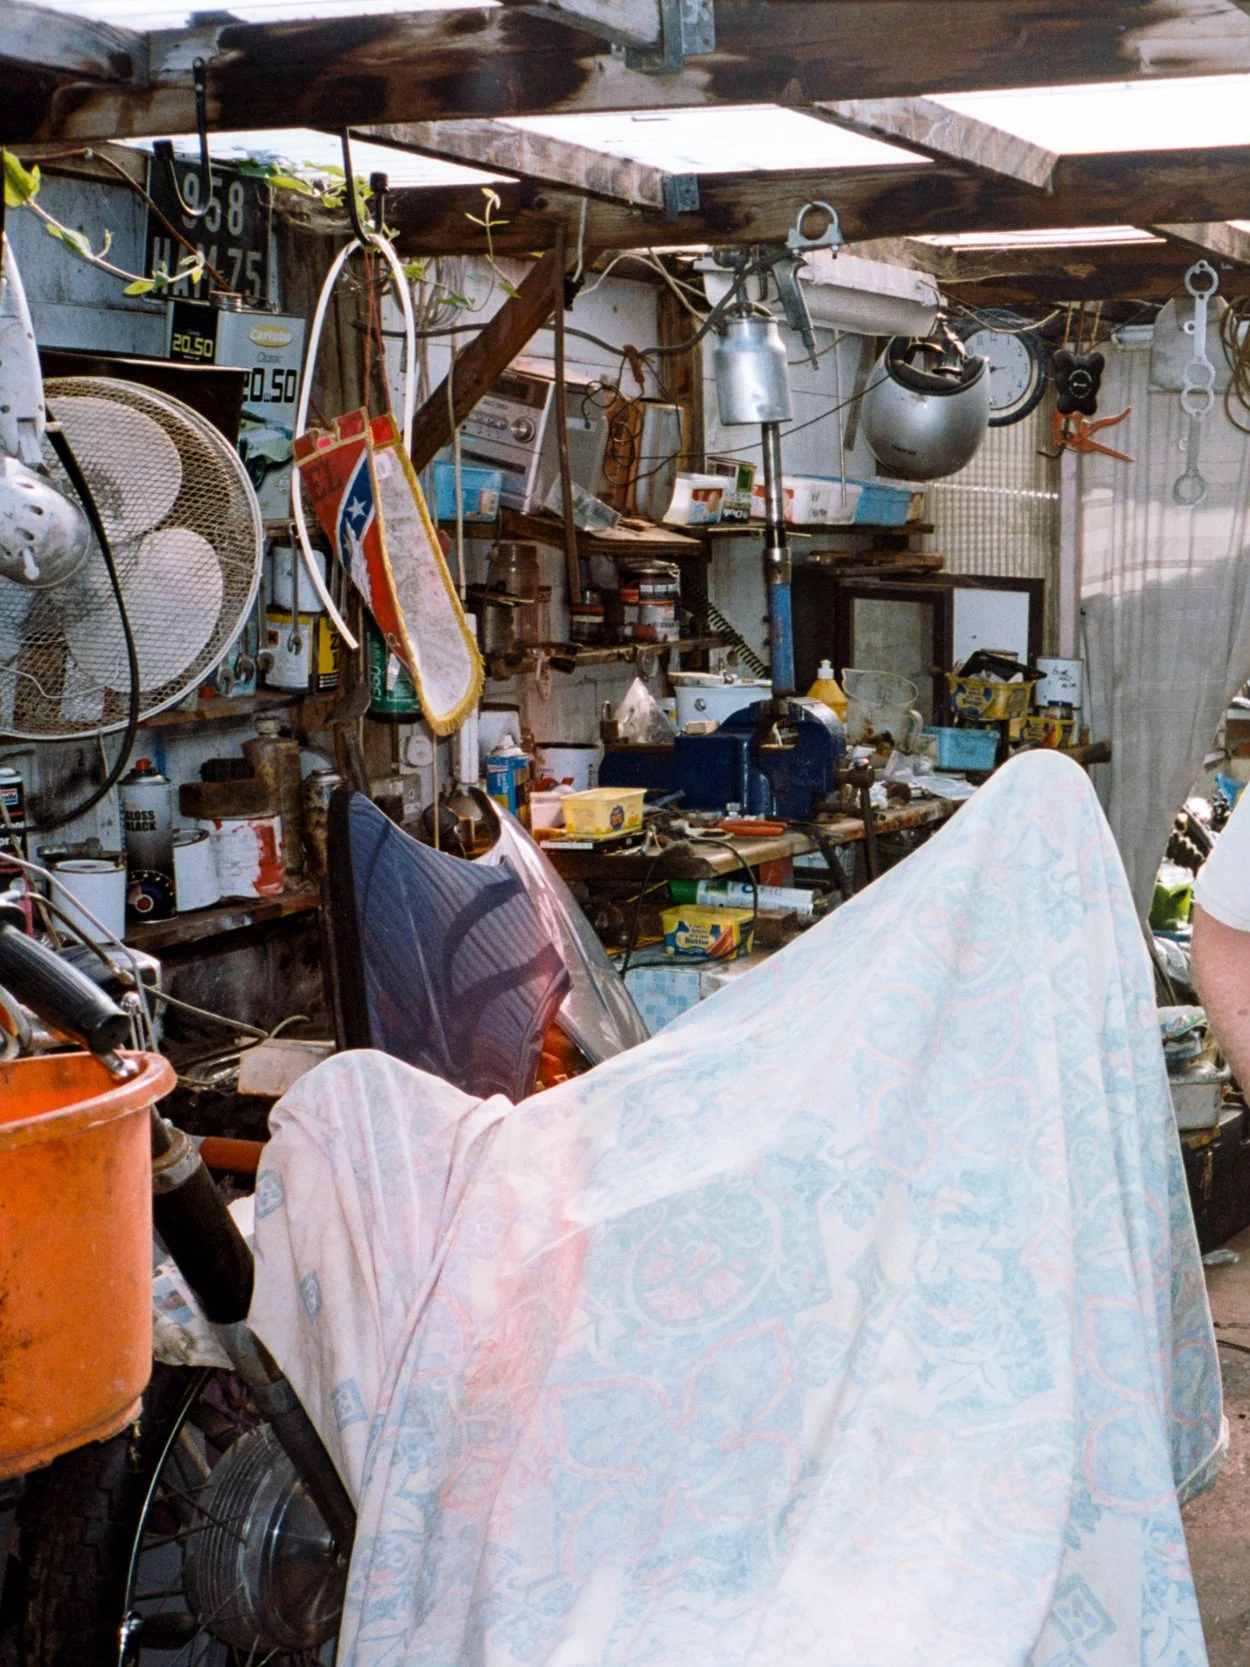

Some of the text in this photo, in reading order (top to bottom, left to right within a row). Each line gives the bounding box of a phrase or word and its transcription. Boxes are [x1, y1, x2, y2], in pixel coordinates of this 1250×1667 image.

[182, 172, 244, 236] 958
[125, 810, 155, 821] GLOSS
[126, 821, 157, 832] BLACK
